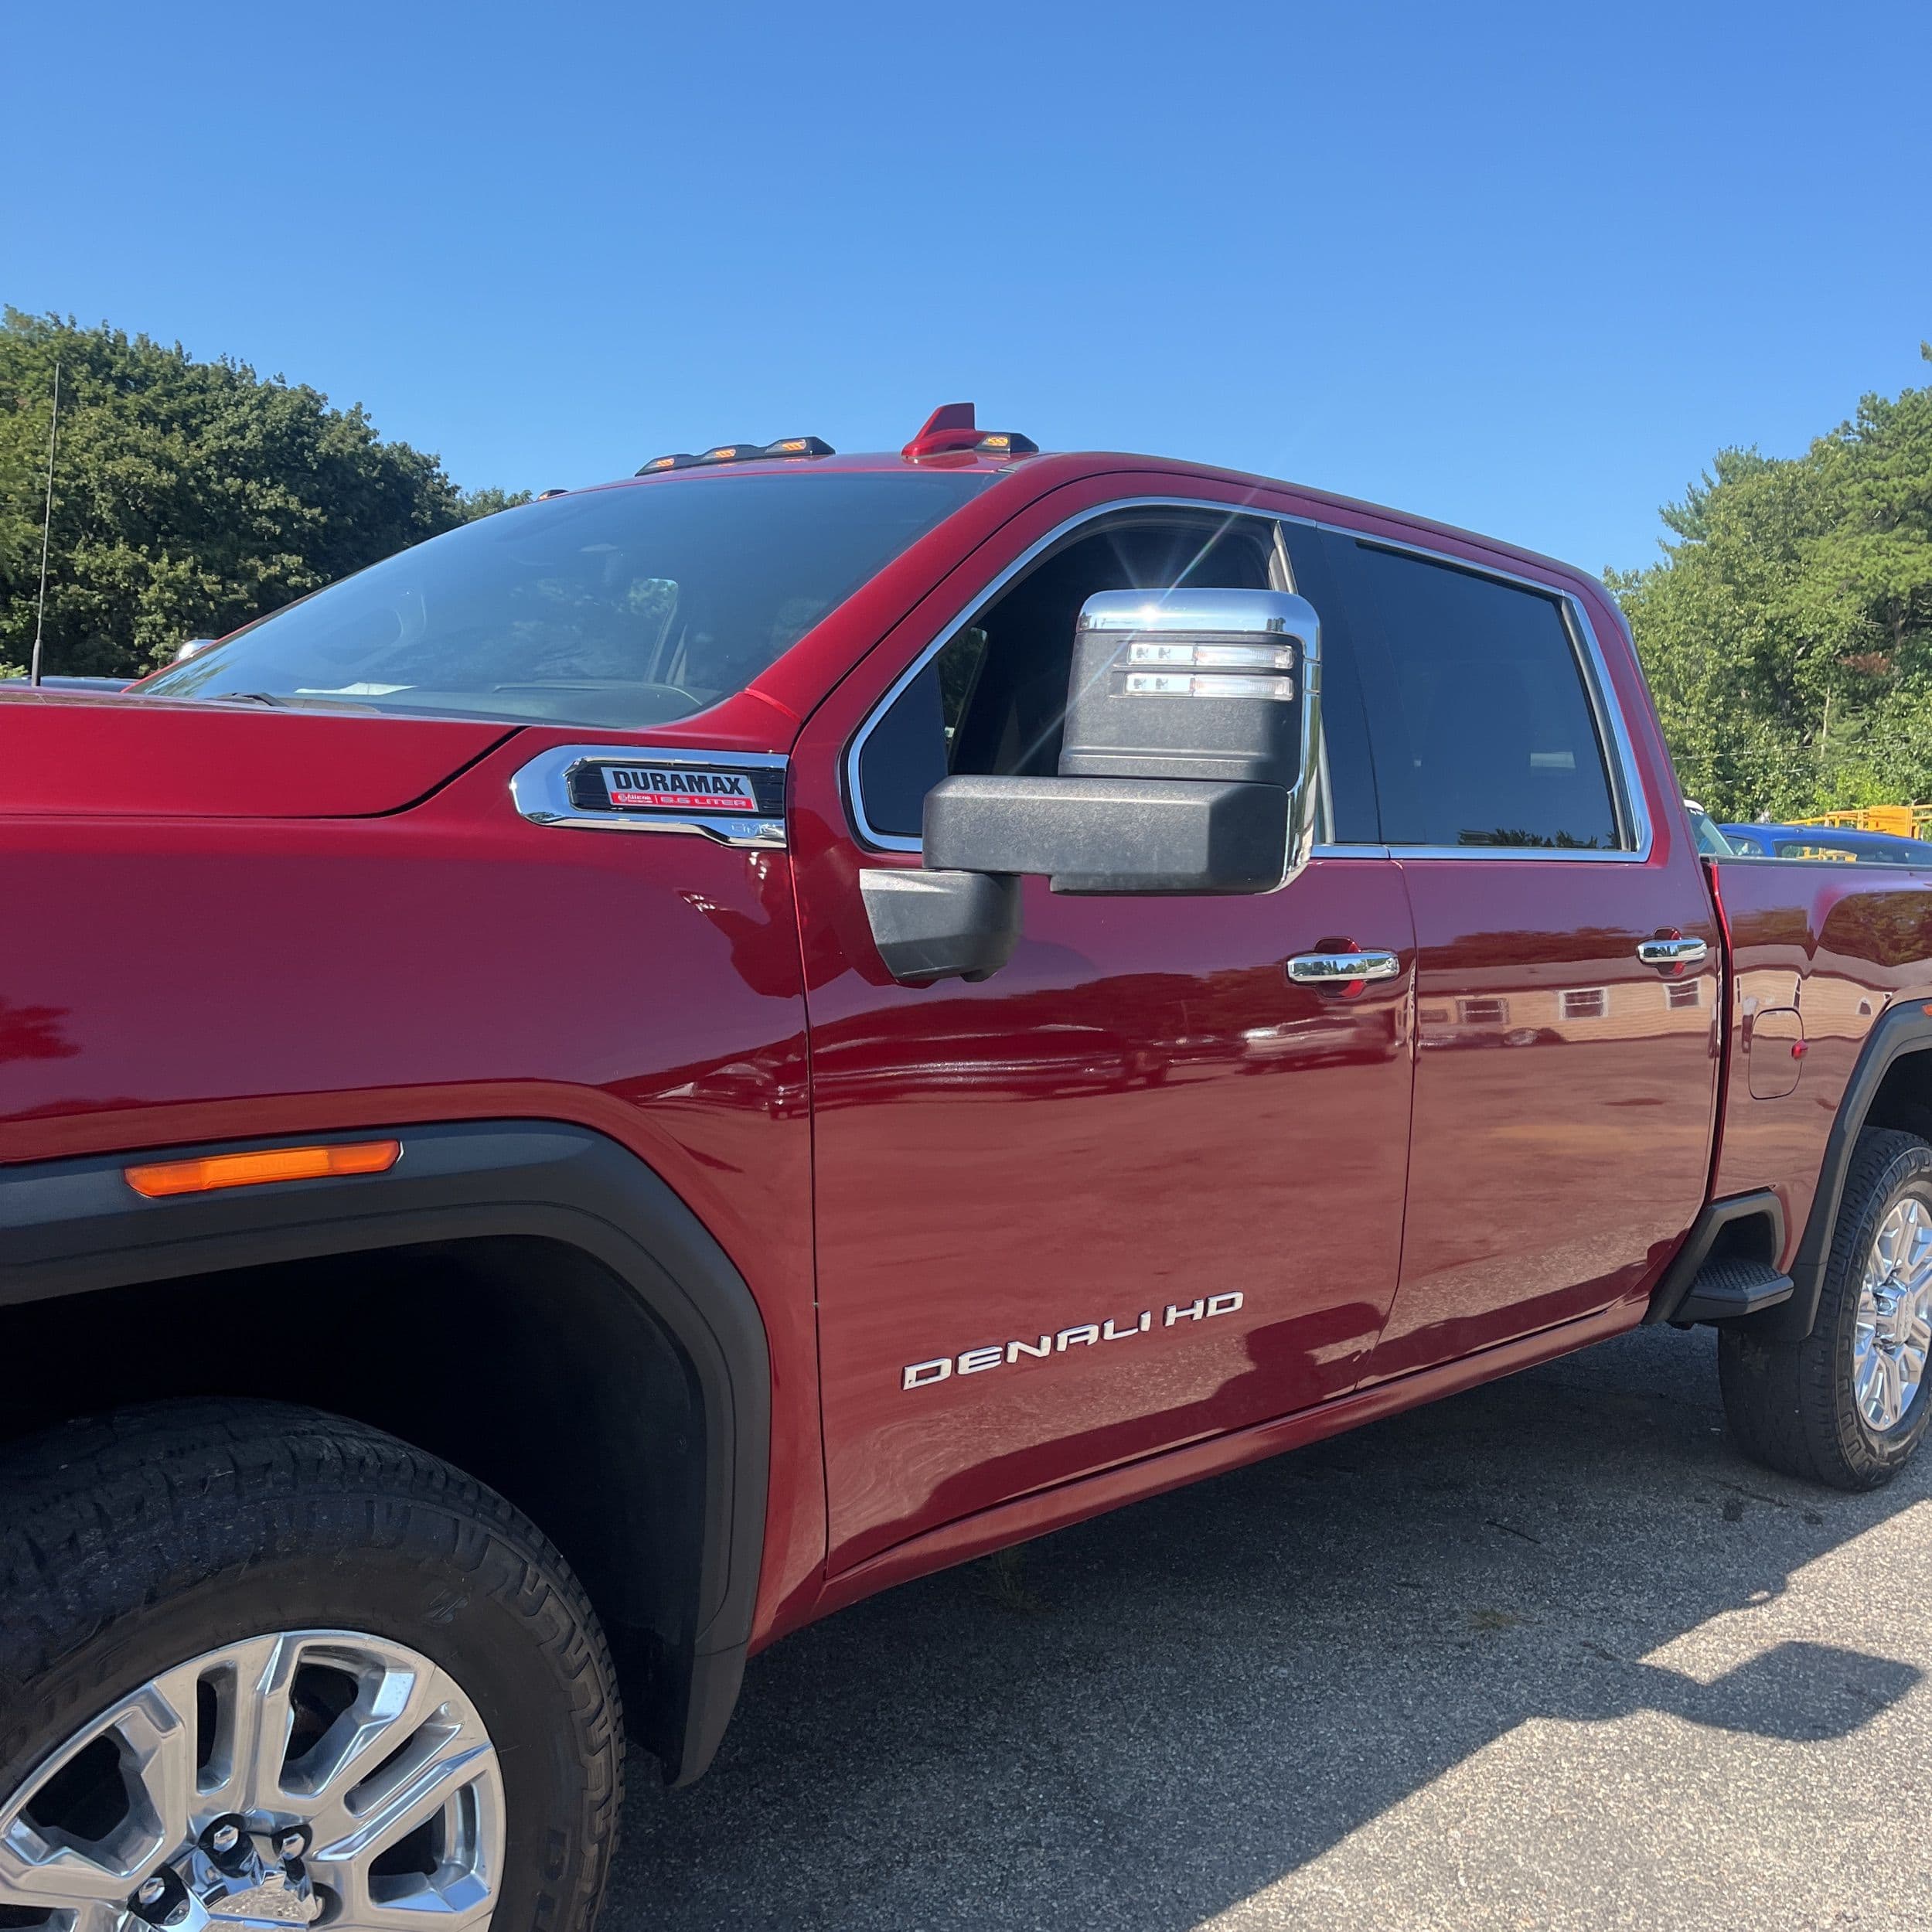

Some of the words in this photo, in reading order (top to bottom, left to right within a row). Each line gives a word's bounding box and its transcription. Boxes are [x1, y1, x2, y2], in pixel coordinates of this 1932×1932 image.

[612, 771, 745, 796] DURAMAX
[695, 798, 746, 806] LITER
[902, 1310, 1151, 1391] DENALI
[1163, 1290, 1244, 1327] HD
